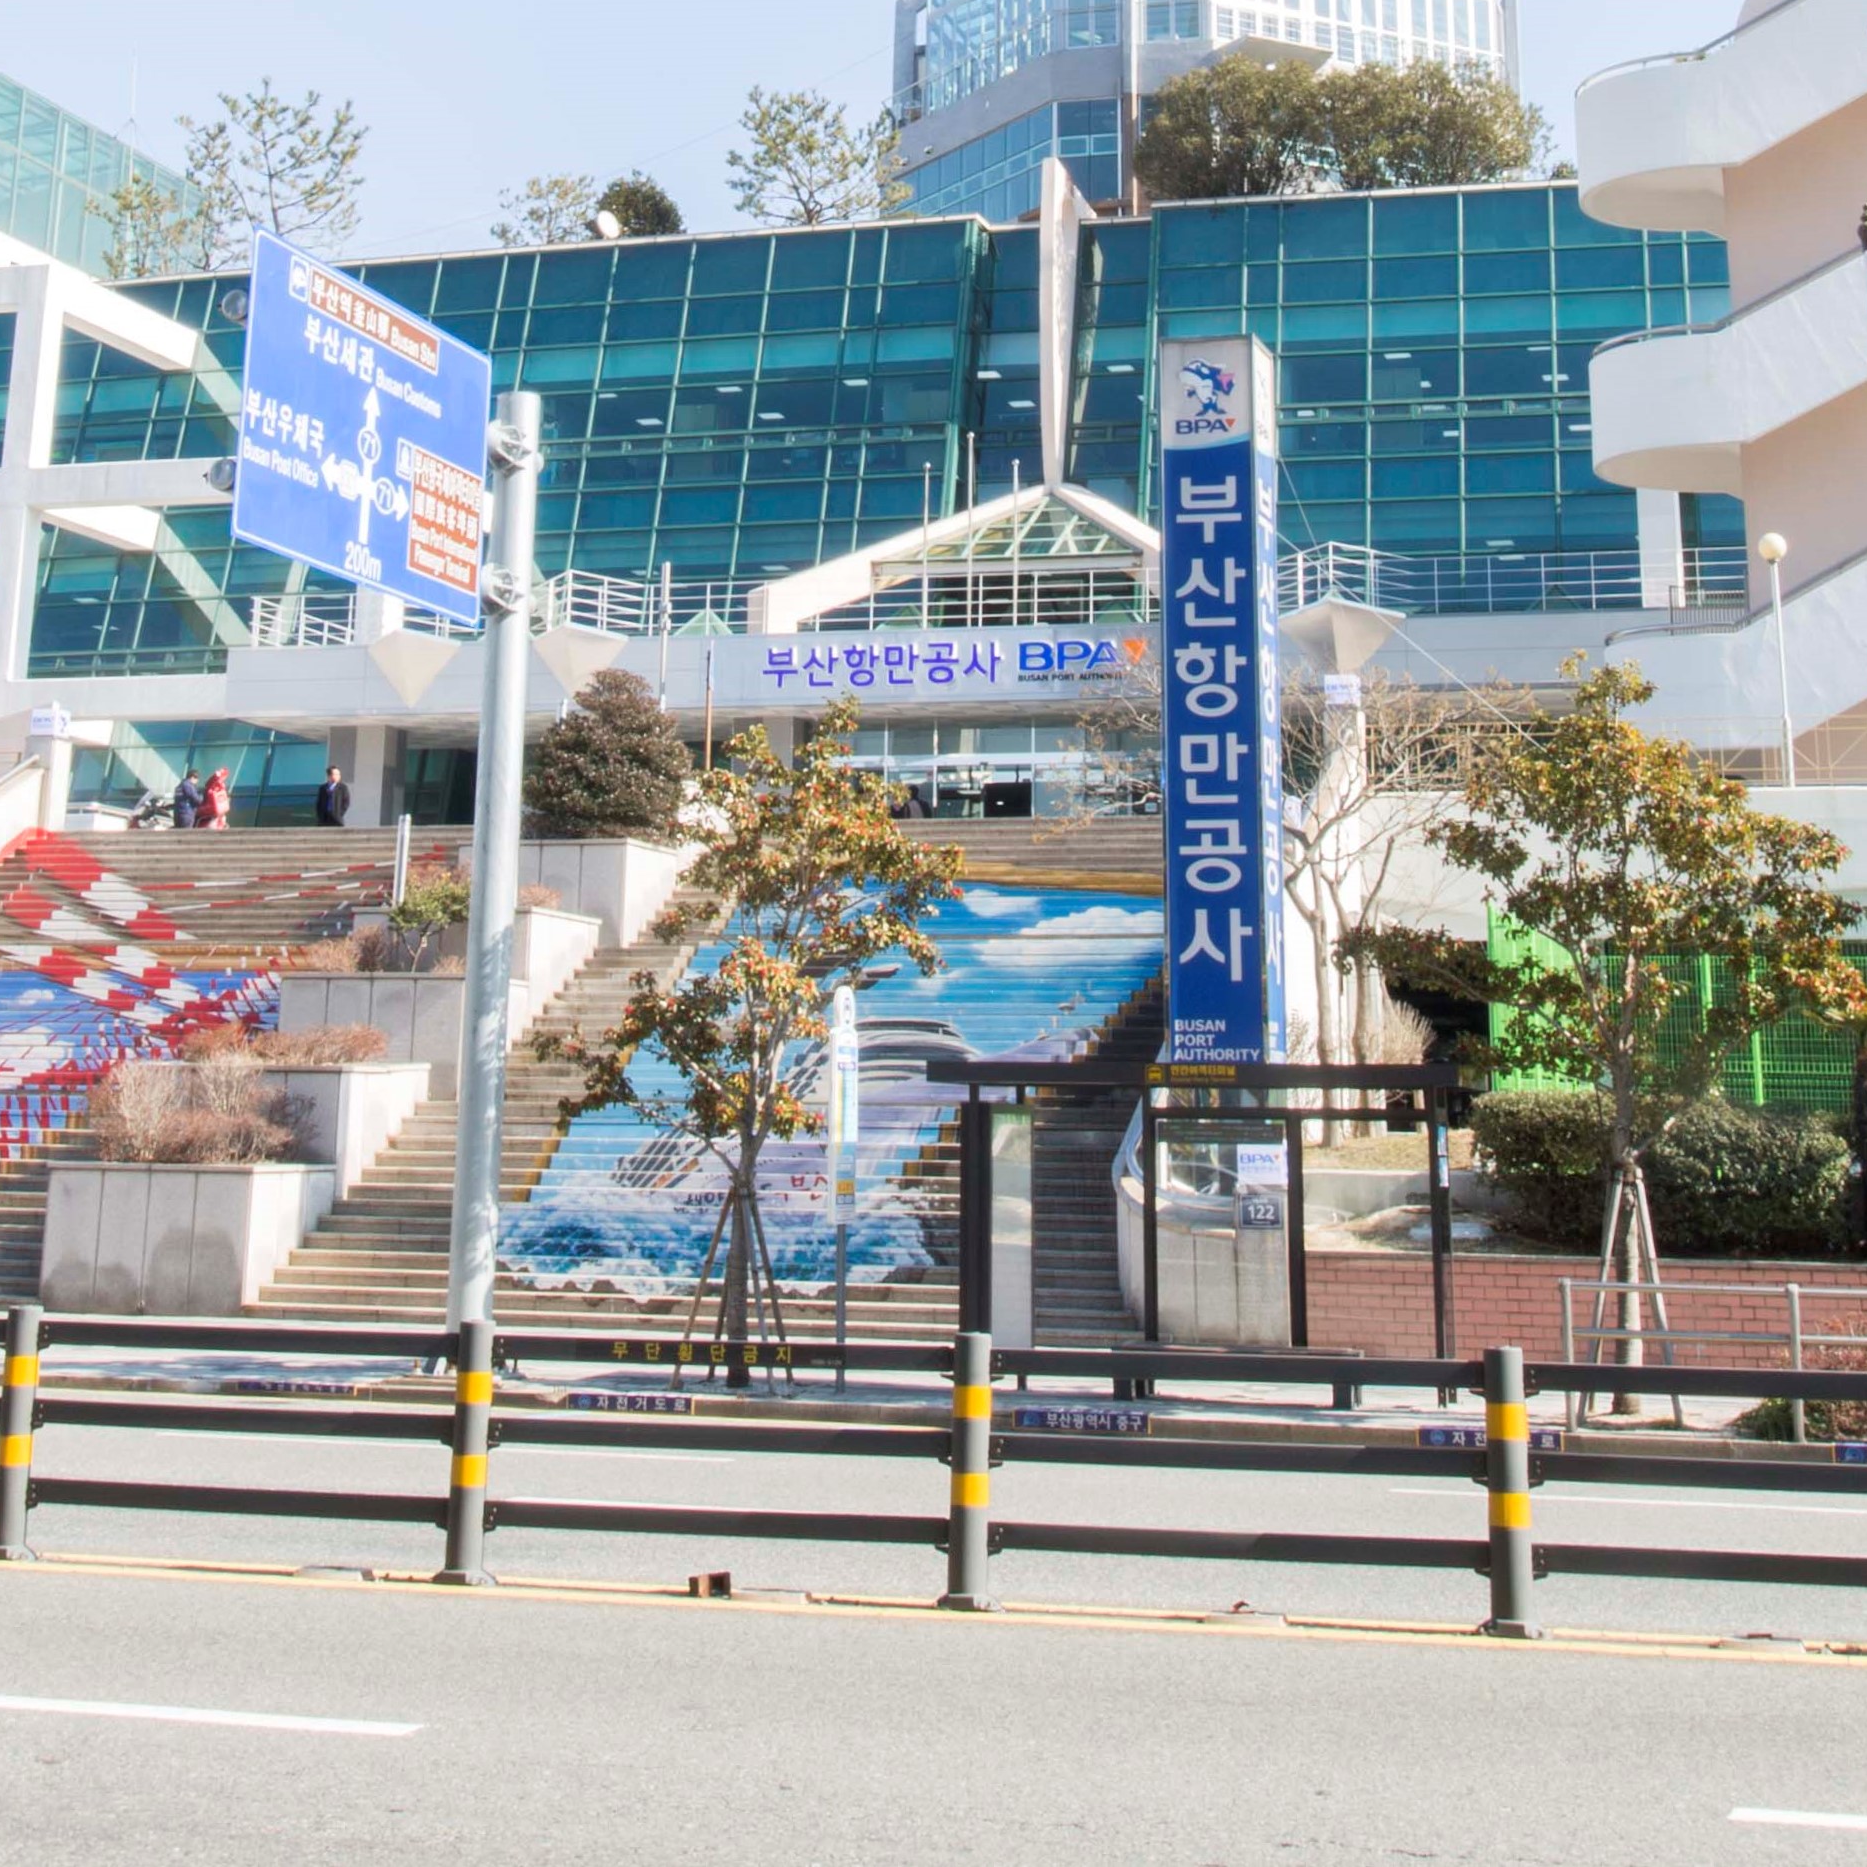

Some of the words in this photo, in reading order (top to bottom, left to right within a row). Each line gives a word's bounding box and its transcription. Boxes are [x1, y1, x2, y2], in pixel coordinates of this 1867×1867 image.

[305, 314, 374, 383] 부산세관
[391, 326, 419, 358] Busan
[376, 367, 404, 399] Busan
[246, 388, 325, 459] 부산우체국
[1176, 419, 1229, 435] BPA
[363, 431, 376, 457] 71
[243, 436, 270, 467] Busan
[271, 449, 292, 479] Post
[292, 458, 319, 488] Office
[378, 483, 391, 509] 71
[345, 541, 382, 581] 200m
[763, 642, 1001, 688] 부산항만공사
[1018, 641, 1121, 671] BPA
[1018, 674, 1049, 682] BUSAN
[1052, 673, 1075, 681] PORT
[1174, 475, 1253, 982] 부산항만공사
[1174, 1019, 1226, 1032] BUSAN
[1174, 1034, 1215, 1046] PORT
[1174, 1048, 1260, 1061] AUTHORITY
[1240, 1154, 1274, 1164] BPA
[1248, 1204, 1275, 1220] 122
[1046, 1411, 1111, 1429] 부산광역시
[1116, 1415, 1142, 1432] 중구
